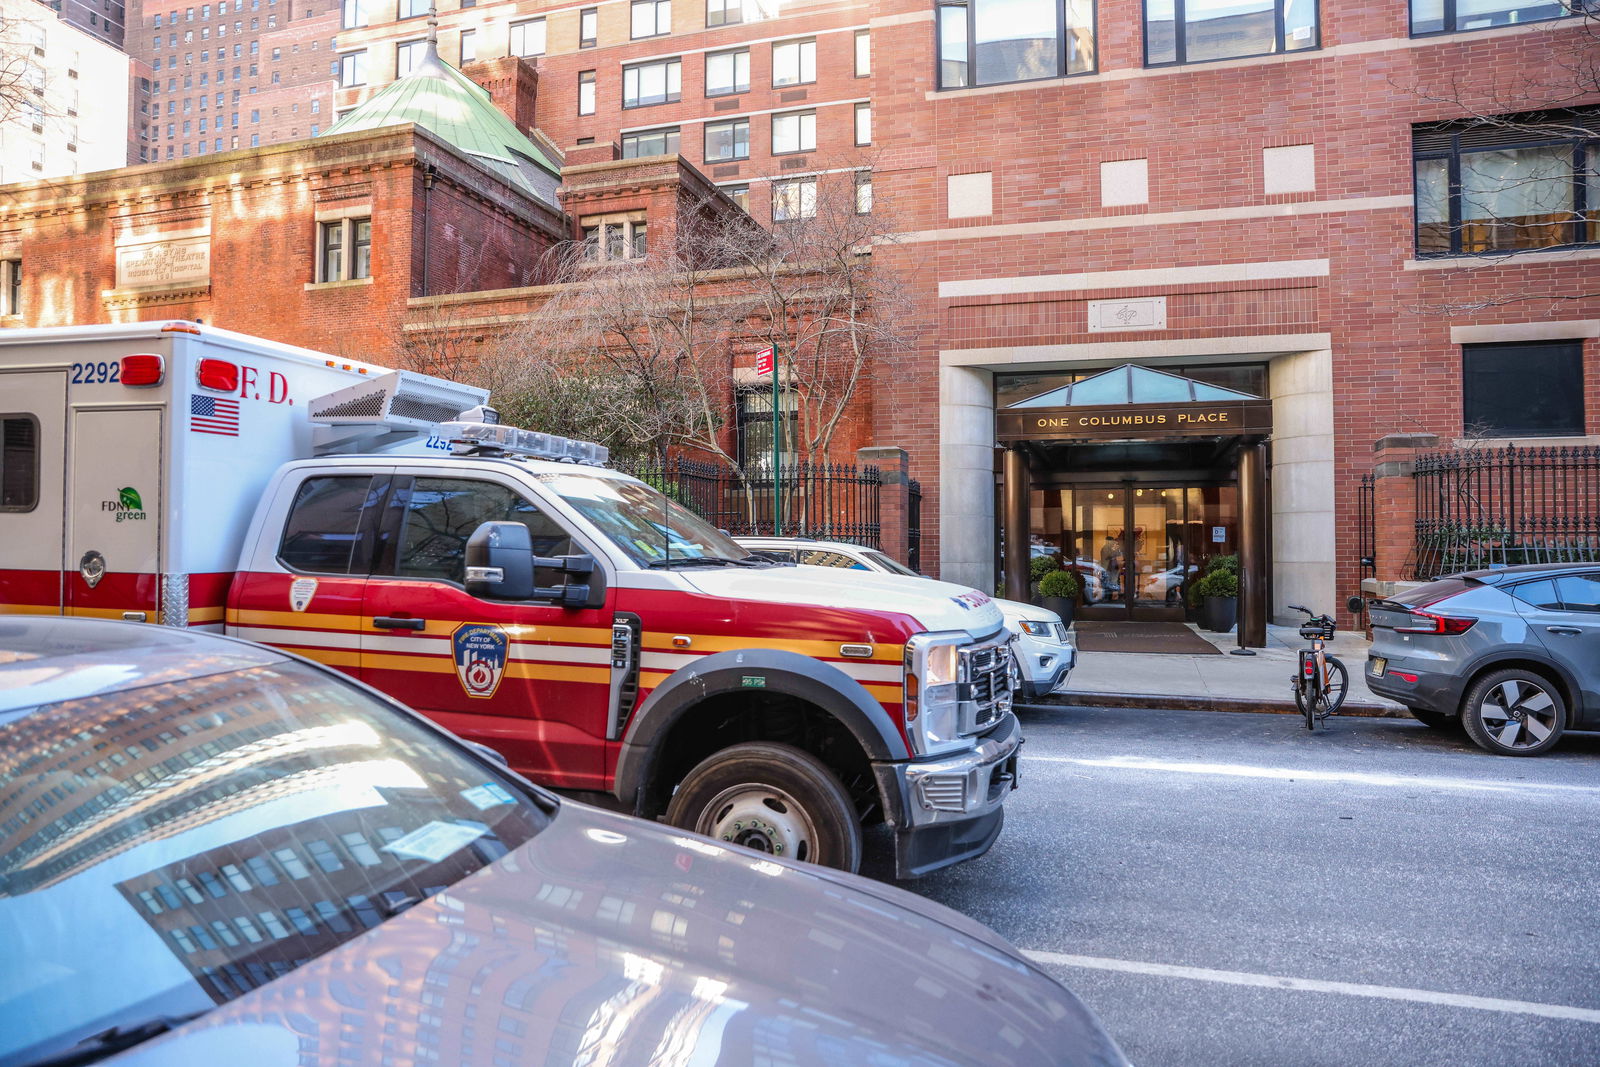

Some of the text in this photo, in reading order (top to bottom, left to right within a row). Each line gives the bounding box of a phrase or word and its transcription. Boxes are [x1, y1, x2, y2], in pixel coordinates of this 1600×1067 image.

[171, 251, 205, 262] THEATRE
[170, 262, 203, 273] HOSPITAL
[72, 361, 120, 384] 2292
[239, 365, 294, 406] F. D.
[1037, 412, 1229, 427] ONE COLUMBUS PLACE
[101, 500, 131, 511] FDNY
[115, 511, 147, 523] green
[458, 628, 502, 646] FIRE DEPARTMENT
